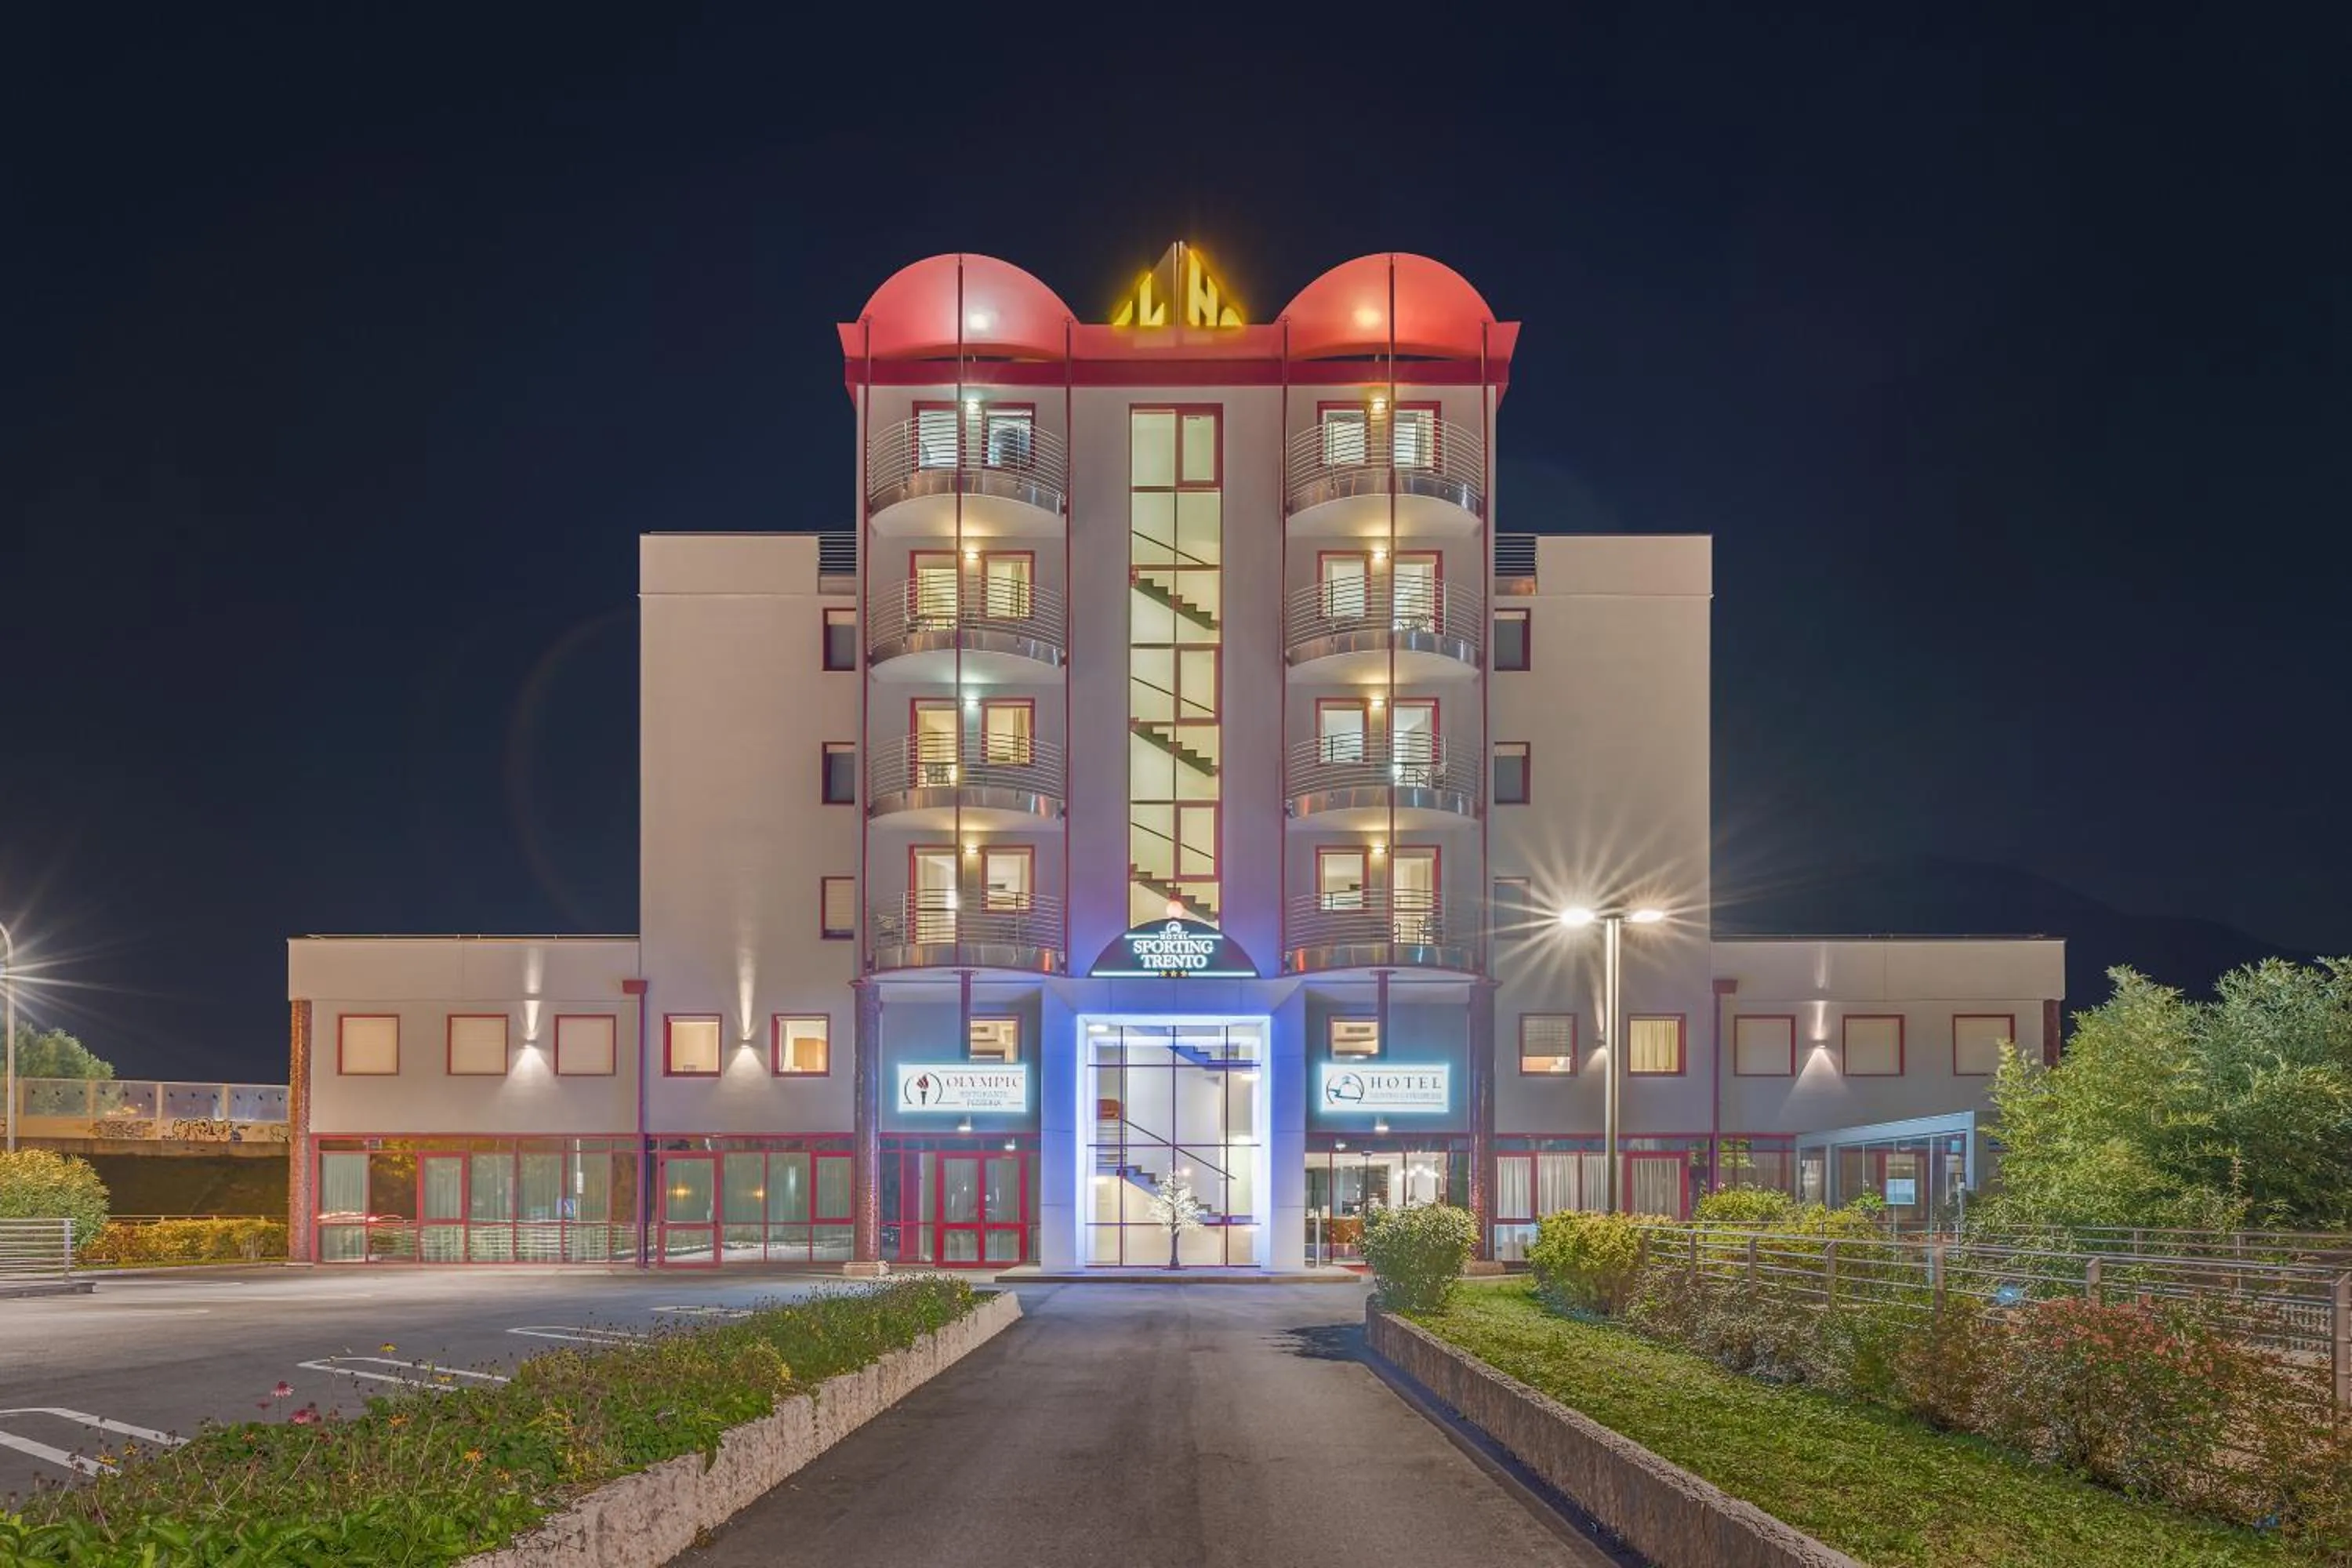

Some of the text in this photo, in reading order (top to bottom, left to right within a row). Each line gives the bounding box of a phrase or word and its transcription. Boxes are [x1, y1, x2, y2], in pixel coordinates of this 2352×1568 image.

[1133, 940, 1214, 954] SPORTING
[1141, 954, 1207, 968] TRENTO
[1370, 1076, 1442, 1089] HOTEL
